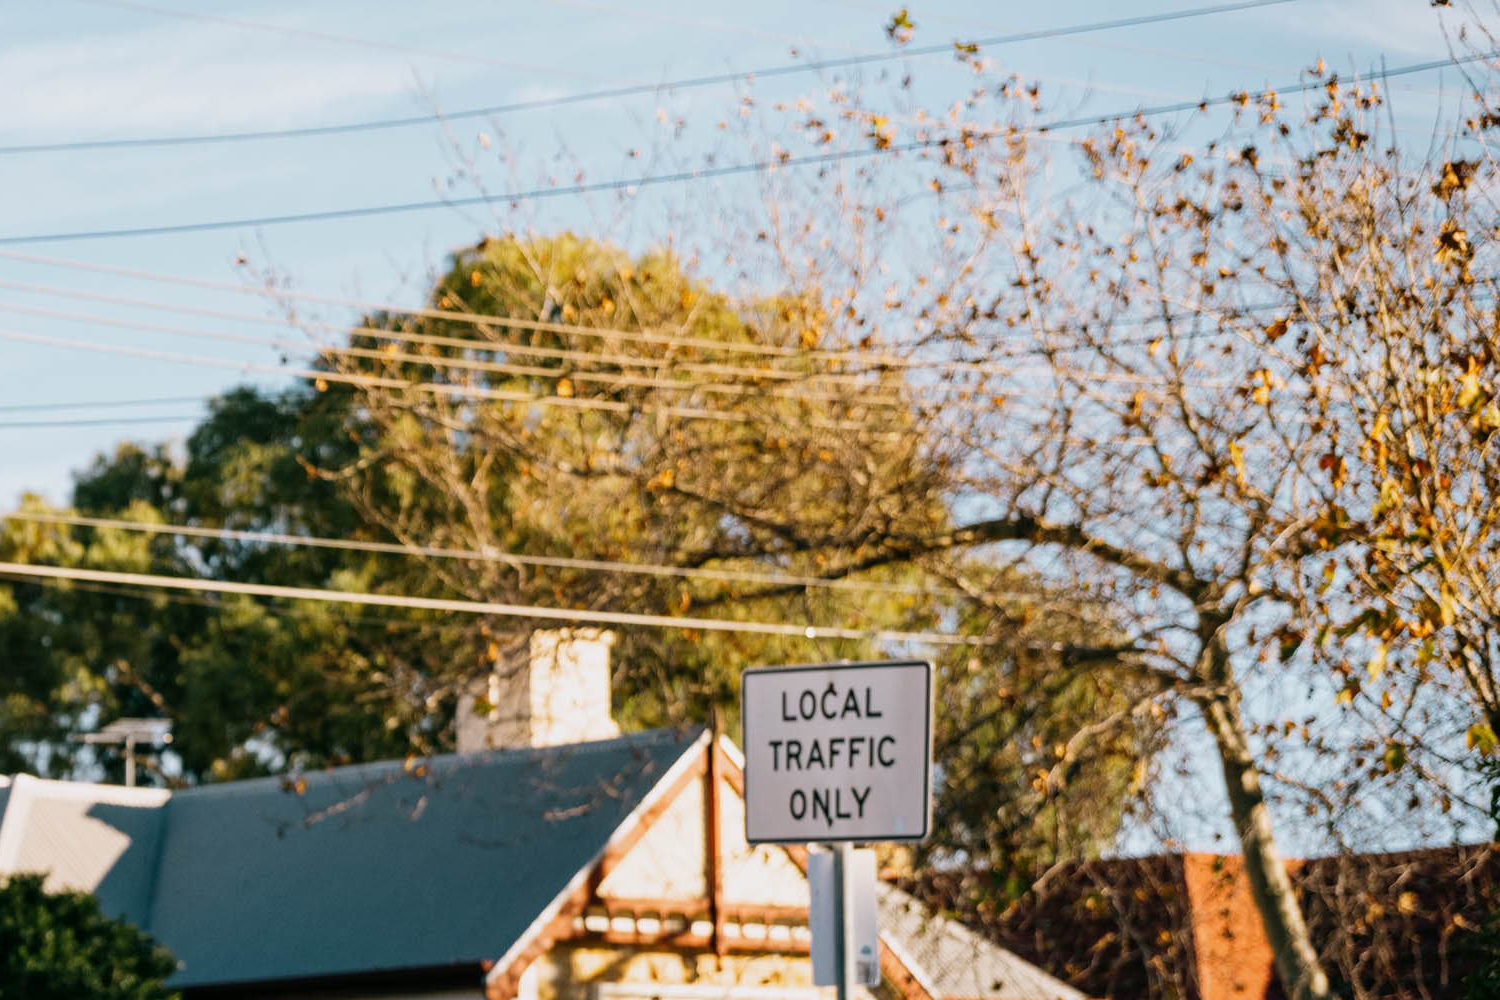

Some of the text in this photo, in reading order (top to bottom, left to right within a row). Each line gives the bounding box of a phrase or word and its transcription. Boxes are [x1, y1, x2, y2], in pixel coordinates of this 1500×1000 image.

[782, 687, 883, 721] LOCAL
[768, 736, 896, 771] TRAFFIC
[789, 786, 871, 822] ONLY
